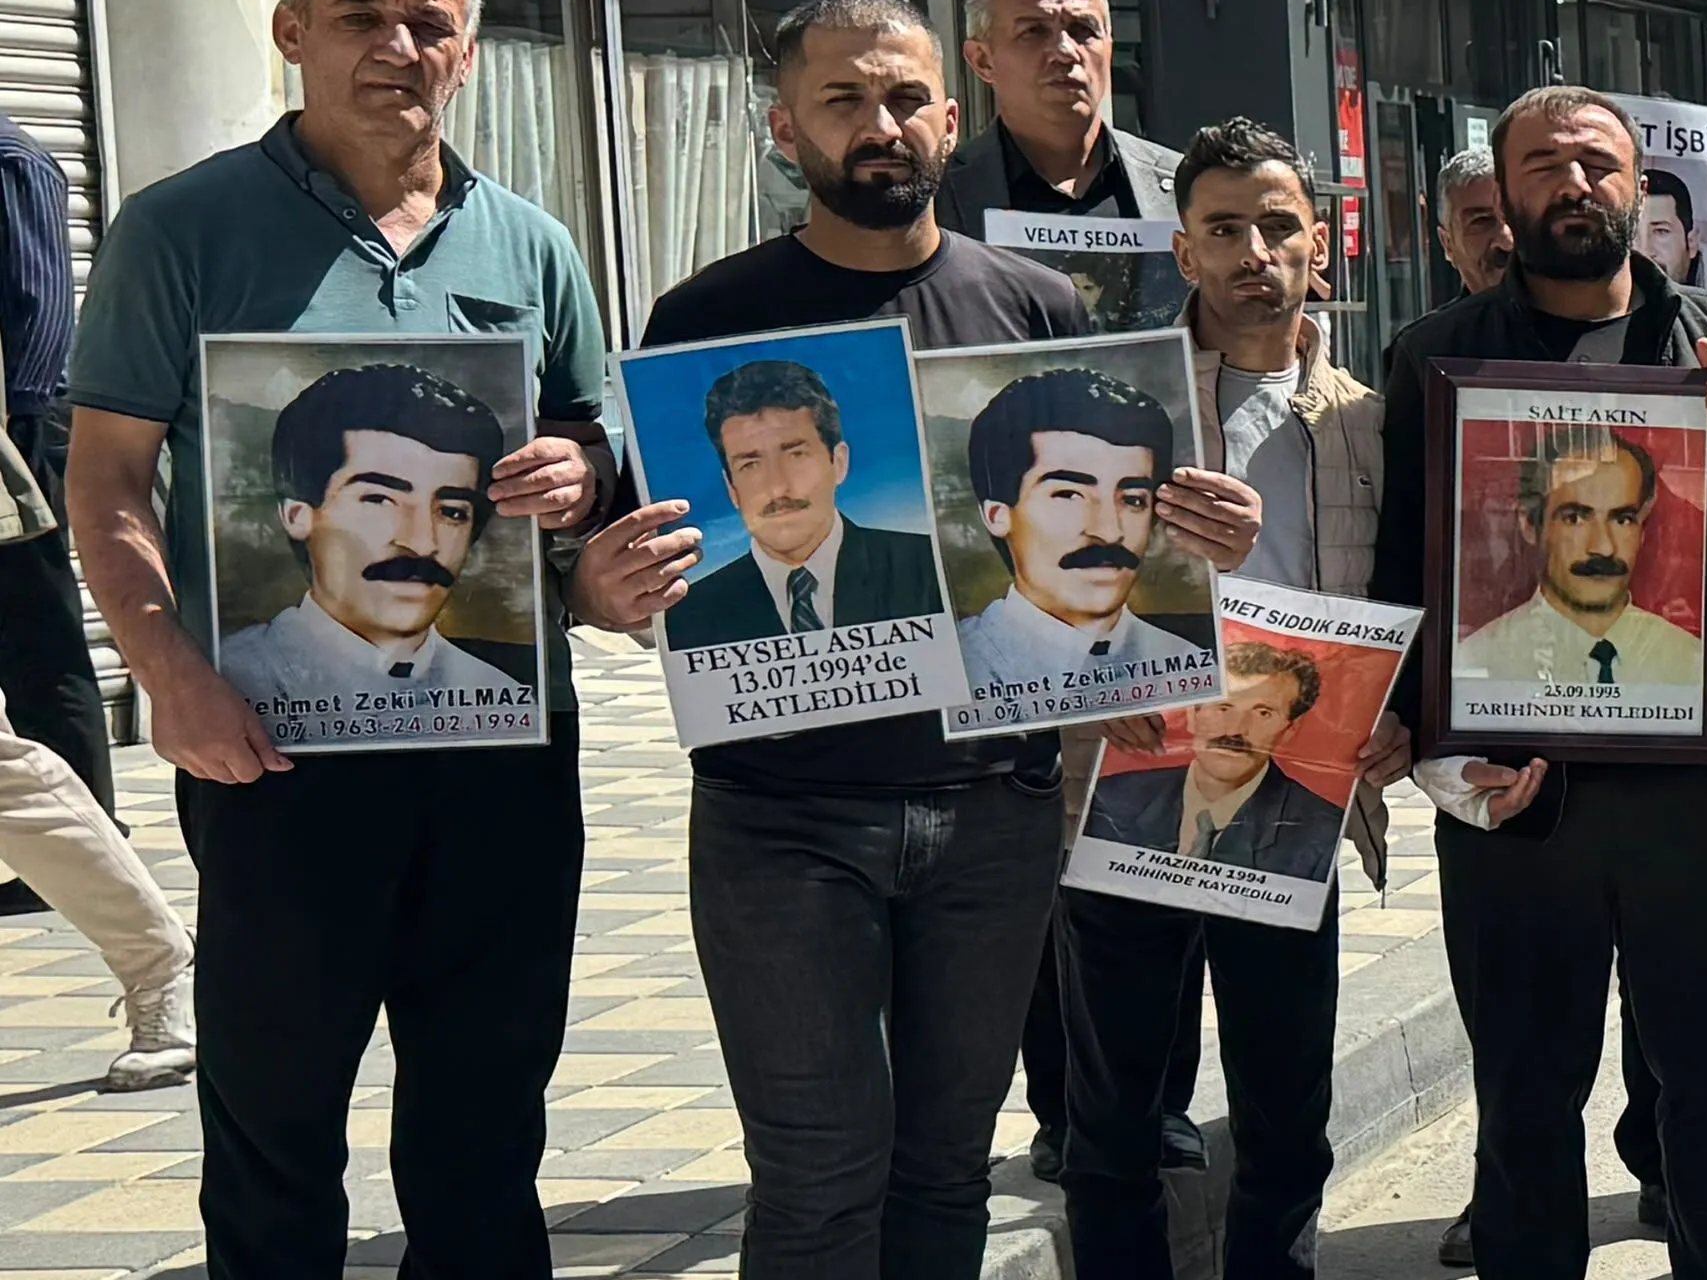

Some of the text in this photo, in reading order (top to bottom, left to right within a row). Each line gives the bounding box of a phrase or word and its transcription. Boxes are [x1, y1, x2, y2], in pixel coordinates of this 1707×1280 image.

[1024, 226, 1144, 249] VELAT ŞEDAL
[1527, 404, 1648, 425] SAİT AKIN
[1219, 596, 1407, 646] MET SIDDIK BAYSAL
[684, 616, 936, 675] FEYSEL ASLAN
[728, 654, 908, 696] 13.07.1994'de
[973, 647, 1215, 702] ehmet Zeki YILMAZ
[240, 685, 532, 717] ehmet Zeki YILMAZ
[726, 674, 924, 727] KATLEDİLDİ
[1465, 702, 1694, 722] TARİHİNDE KATLEDİLDİ
[1107, 860, 1293, 907] TARİHİNDE KAYBEDİLDİ
[1135, 851, 1268, 887] 7 HAZİRAN 1994
